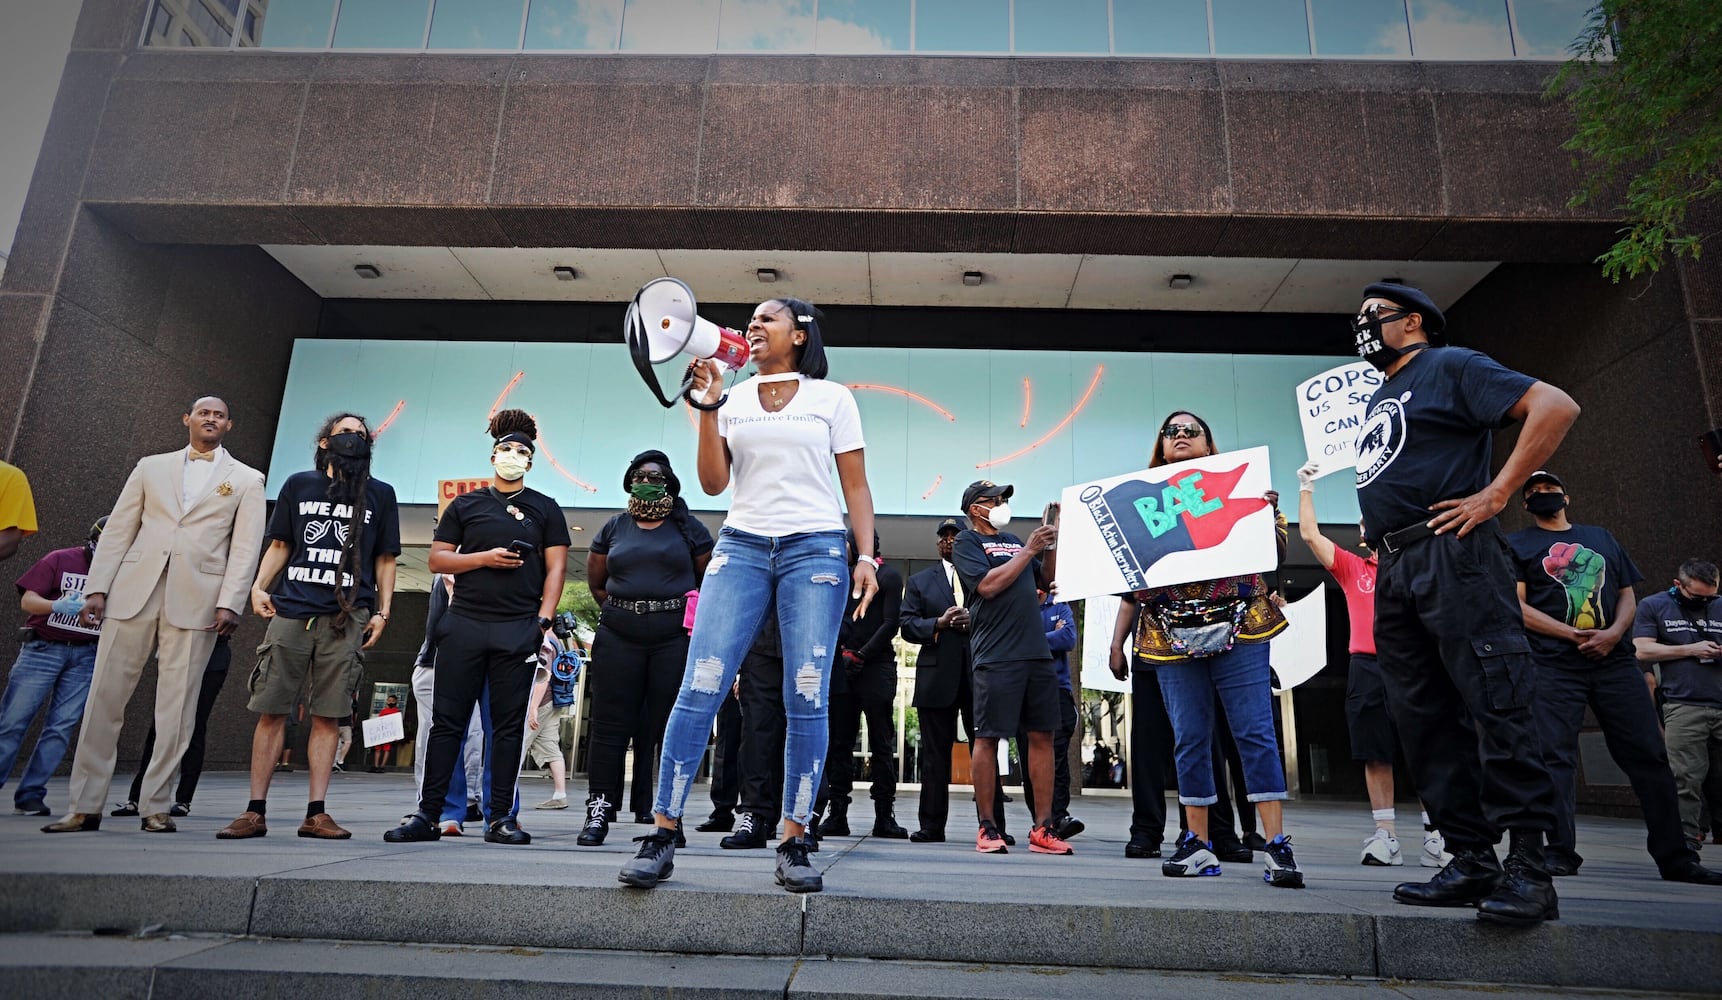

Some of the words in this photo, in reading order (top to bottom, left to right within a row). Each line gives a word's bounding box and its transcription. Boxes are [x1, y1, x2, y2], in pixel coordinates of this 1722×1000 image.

[1306, 368, 1381, 402] COPS
[1309, 400, 1331, 418] US
[1369, 446, 1393, 478] PARTY
[299, 501, 331, 516] WE
[332, 503, 373, 524] AE
[1088, 497, 1110, 525] Black
[1132, 471, 1225, 539] BAE
